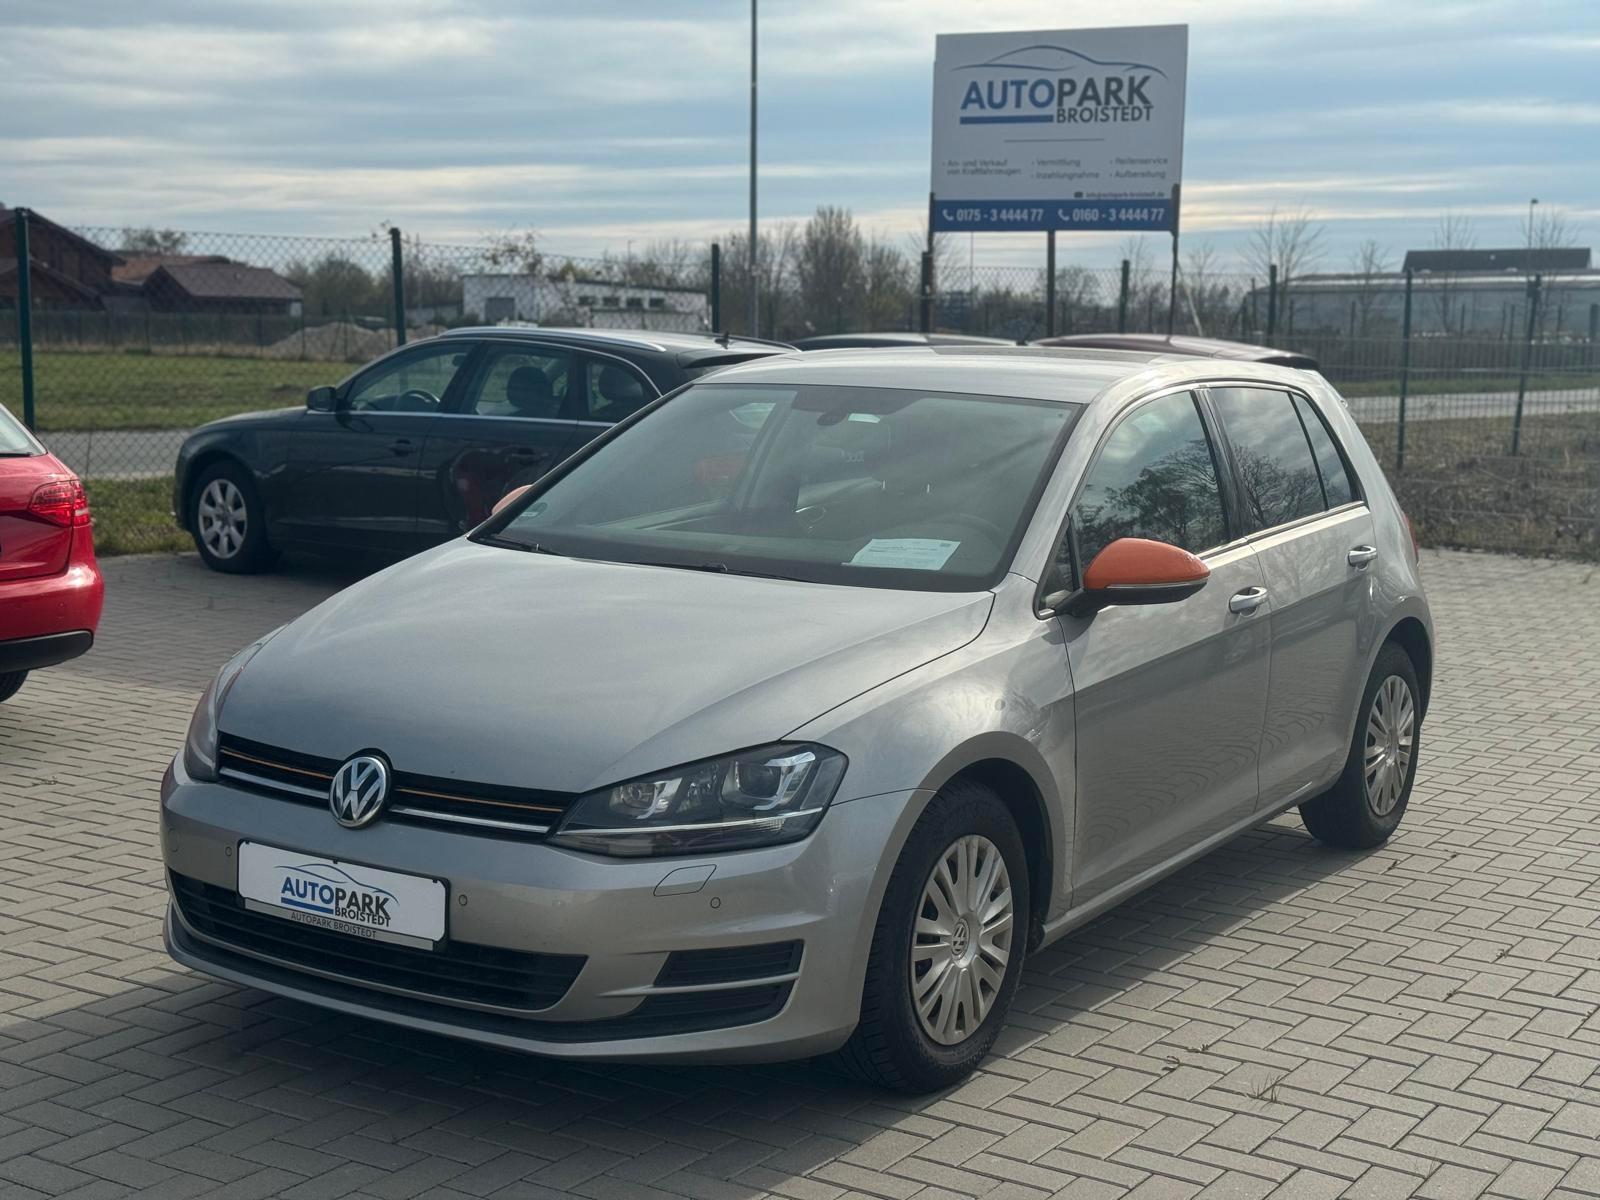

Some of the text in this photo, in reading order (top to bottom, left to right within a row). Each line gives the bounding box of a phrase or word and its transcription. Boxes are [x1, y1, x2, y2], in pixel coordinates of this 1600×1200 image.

[960, 75, 1152, 110] AUTOPARK
[1056, 105, 1153, 124] BROISTEDT
[956, 208, 981, 222] 0175
[1072, 207, 1099, 221] 0160
[281, 876, 390, 918] AUTOPARK
[290, 911, 377, 939] AUTOPARK BROISTEDT
[334, 907, 391, 928] BROISTEDT
